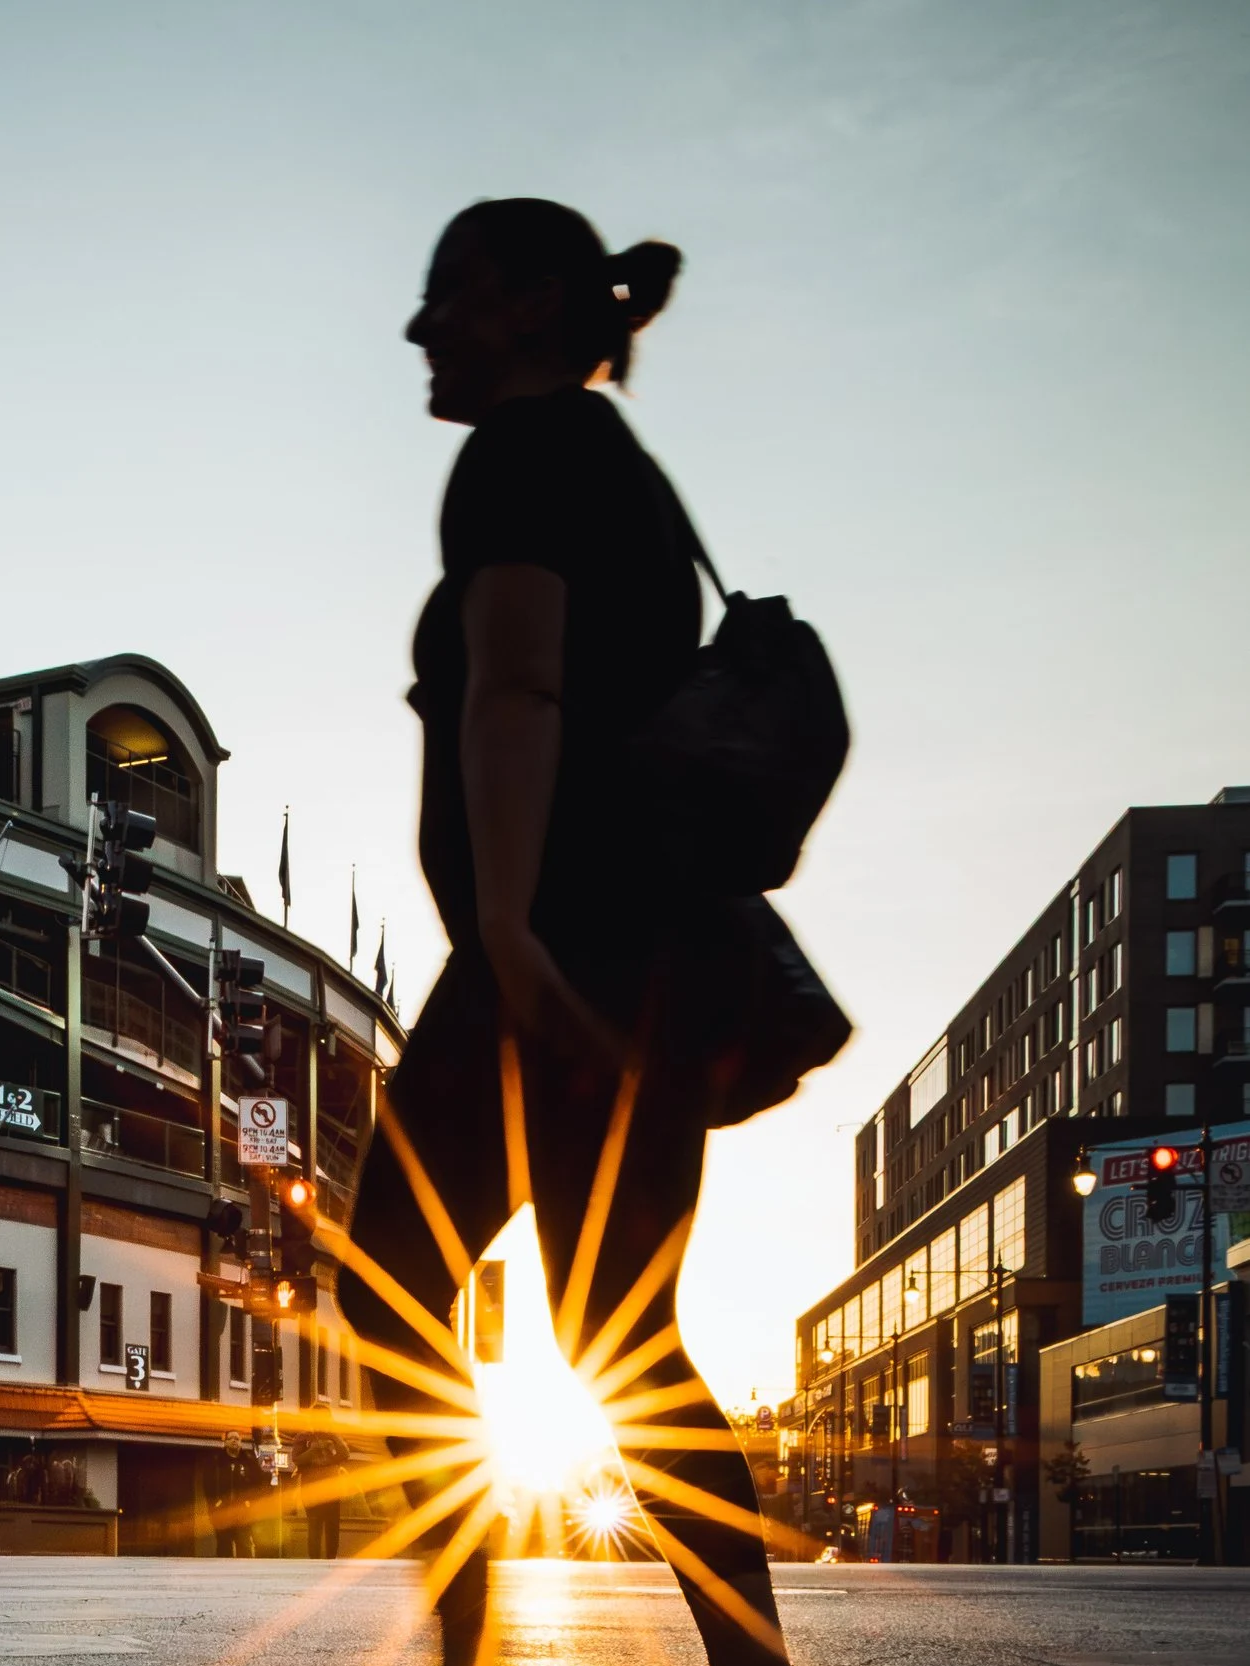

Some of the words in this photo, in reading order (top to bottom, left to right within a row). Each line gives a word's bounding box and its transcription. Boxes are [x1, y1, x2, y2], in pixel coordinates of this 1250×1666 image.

[1099, 1277, 1155, 1293] CERVEZA
[1158, 1271, 1215, 1288] PREMI
[127, 1346, 147, 1356] GATE
[130, 1355, 145, 1380] 3
